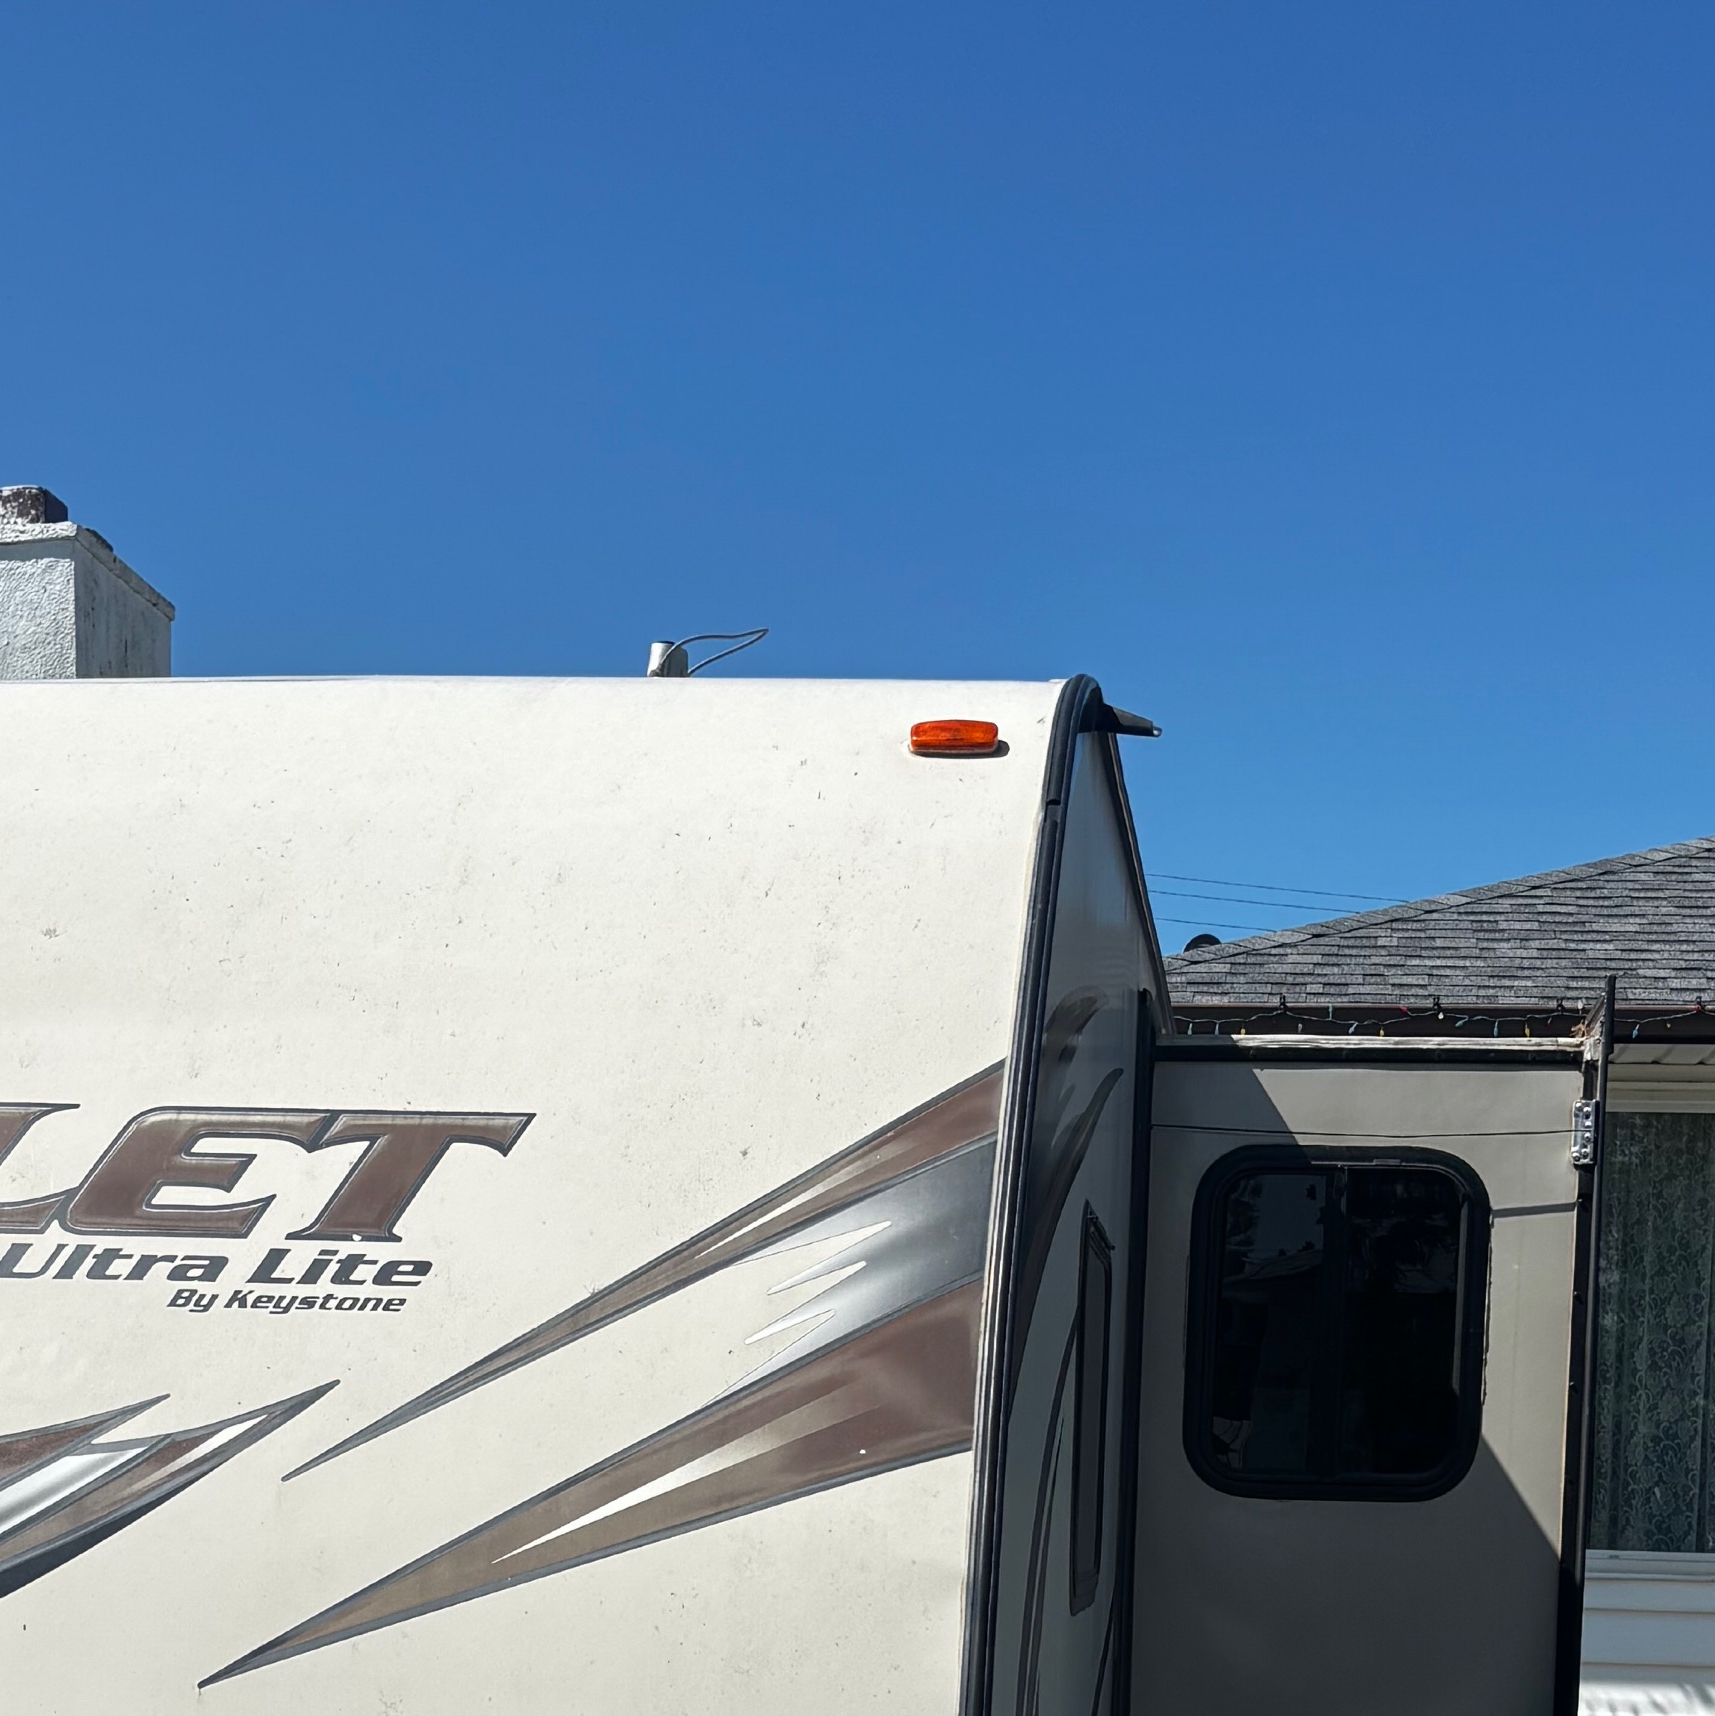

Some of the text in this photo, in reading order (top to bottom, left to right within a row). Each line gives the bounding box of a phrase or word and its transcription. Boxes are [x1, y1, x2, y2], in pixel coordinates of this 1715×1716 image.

[245, 1247, 433, 1286] Lite
[166, 1288, 407, 1314] By Keystone
